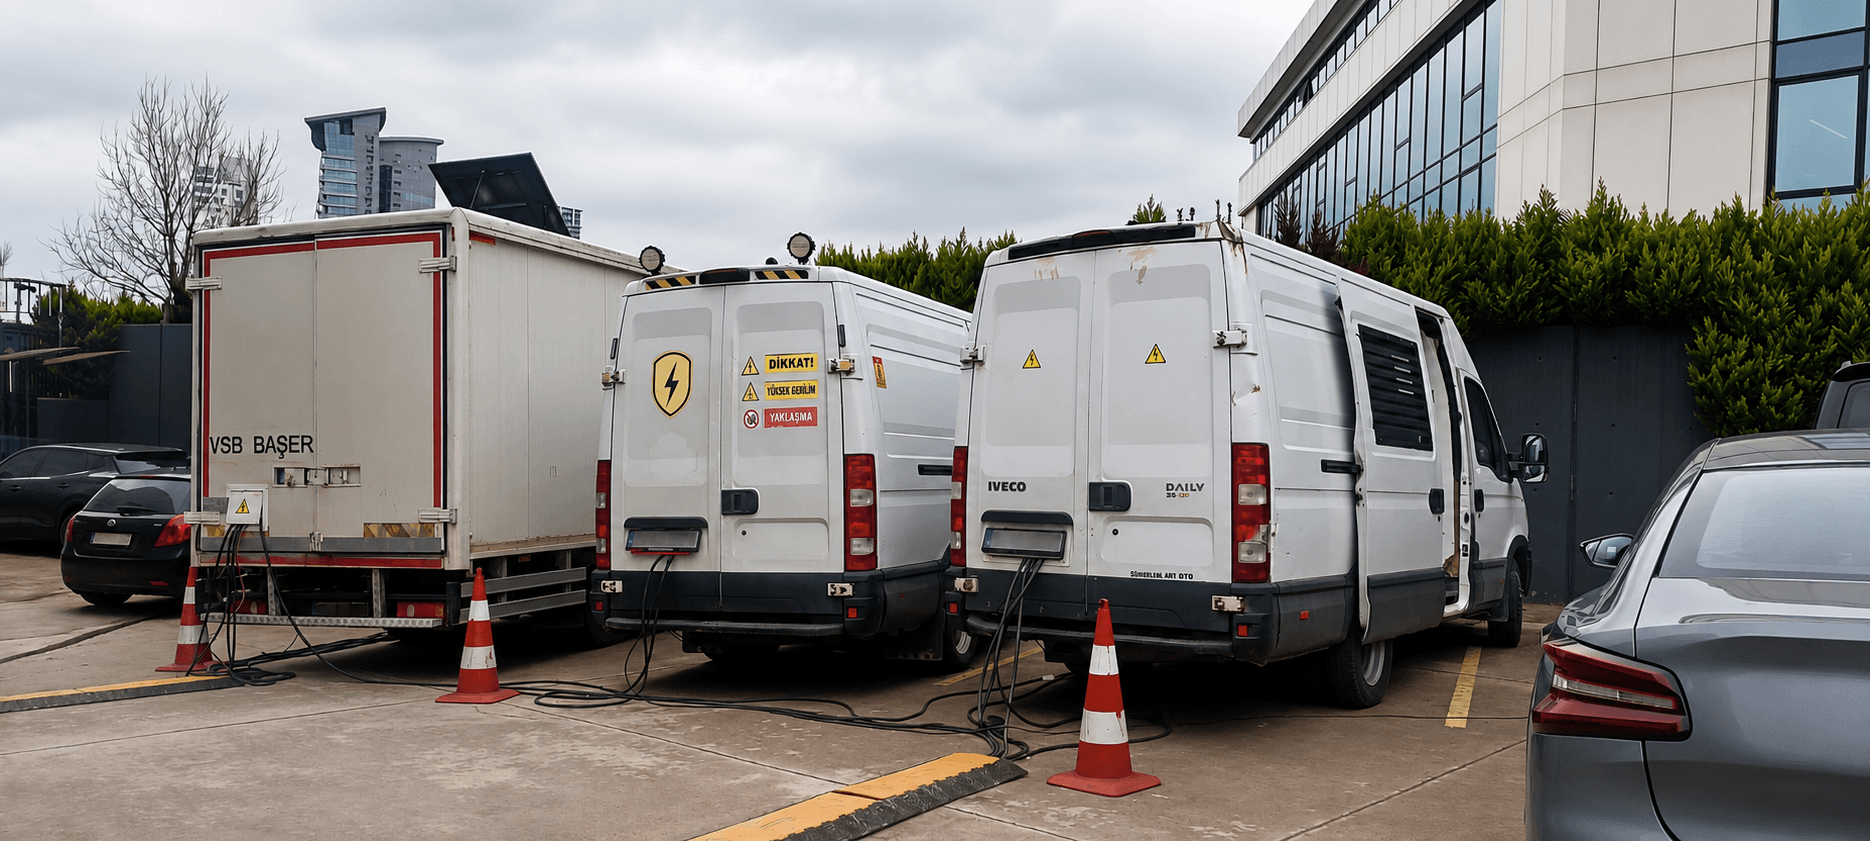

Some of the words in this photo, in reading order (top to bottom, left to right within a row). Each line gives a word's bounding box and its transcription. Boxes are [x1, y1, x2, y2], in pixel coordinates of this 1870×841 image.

[769, 356, 814, 370] DİKKAT!
[767, 384, 790, 396] YÜKSEK
[769, 411, 813, 424] YAKLAŞMA
[209, 436, 243, 454] VSB
[253, 435, 314, 459] BAŞER
[988, 481, 1027, 492] IVECO
